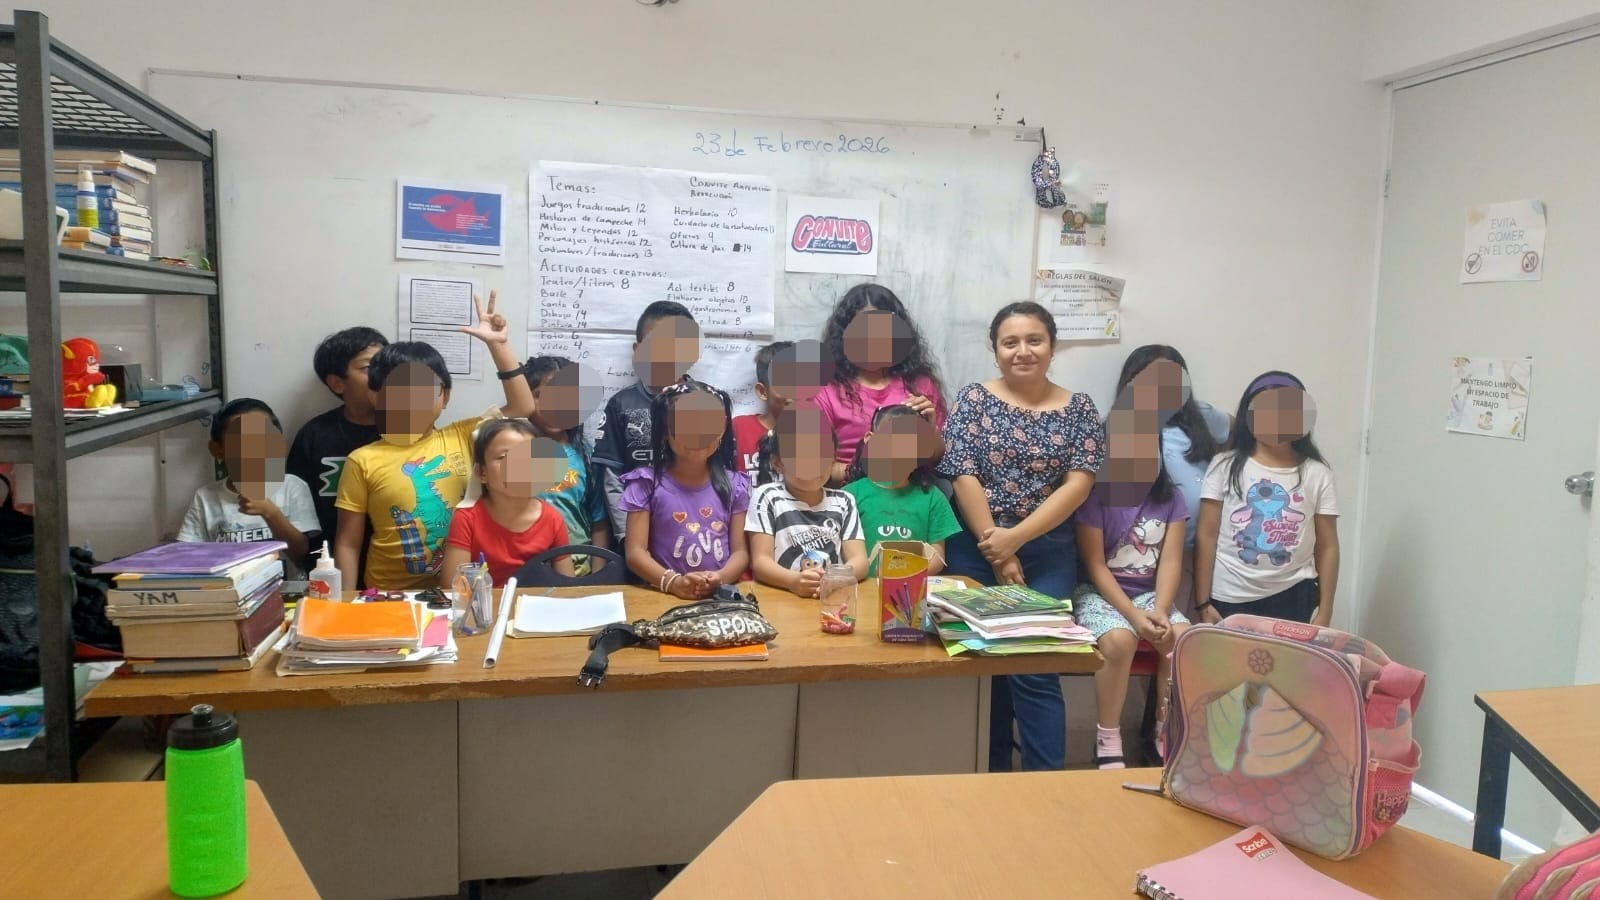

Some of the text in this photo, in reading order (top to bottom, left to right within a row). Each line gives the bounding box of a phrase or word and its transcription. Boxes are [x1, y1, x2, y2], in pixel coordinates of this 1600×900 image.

[692, 128, 890, 156] 23 de Febrero 2026
[547, 176, 596, 193] Temas:
[541, 194, 572, 212] Juegos
[636, 203, 646, 213] 12
[727, 207, 738, 217] 10
[1491, 216, 1517, 230] EVITA
[581, 226, 621, 235] Leyendas
[627, 229, 638, 237] 12
[1488, 230, 1525, 242] COMER
[639, 238, 652, 246] 12
[700, 243, 708, 251] de
[1479, 246, 1490, 256] EN
[1505, 243, 1529, 255] CDC
[540, 258, 607, 275] ACTIVIDADES
[1048, 272, 1073, 280] REGLAS
[620, 277, 630, 290] 8
[727, 281, 735, 292] 8
[577, 289, 584, 299] 7
[745, 305, 751, 313] 8
[575, 310, 587, 320] 14
[574, 341, 582, 350] 4
[1461, 378, 1517, 389] MANTENGO LIMPIO
[1475, 389, 1500, 398] ESPACIO
[1472, 399, 1499, 409] TRABAJO
[673, 530, 723, 567] LOVE
[133, 592, 179, 605] YAM
